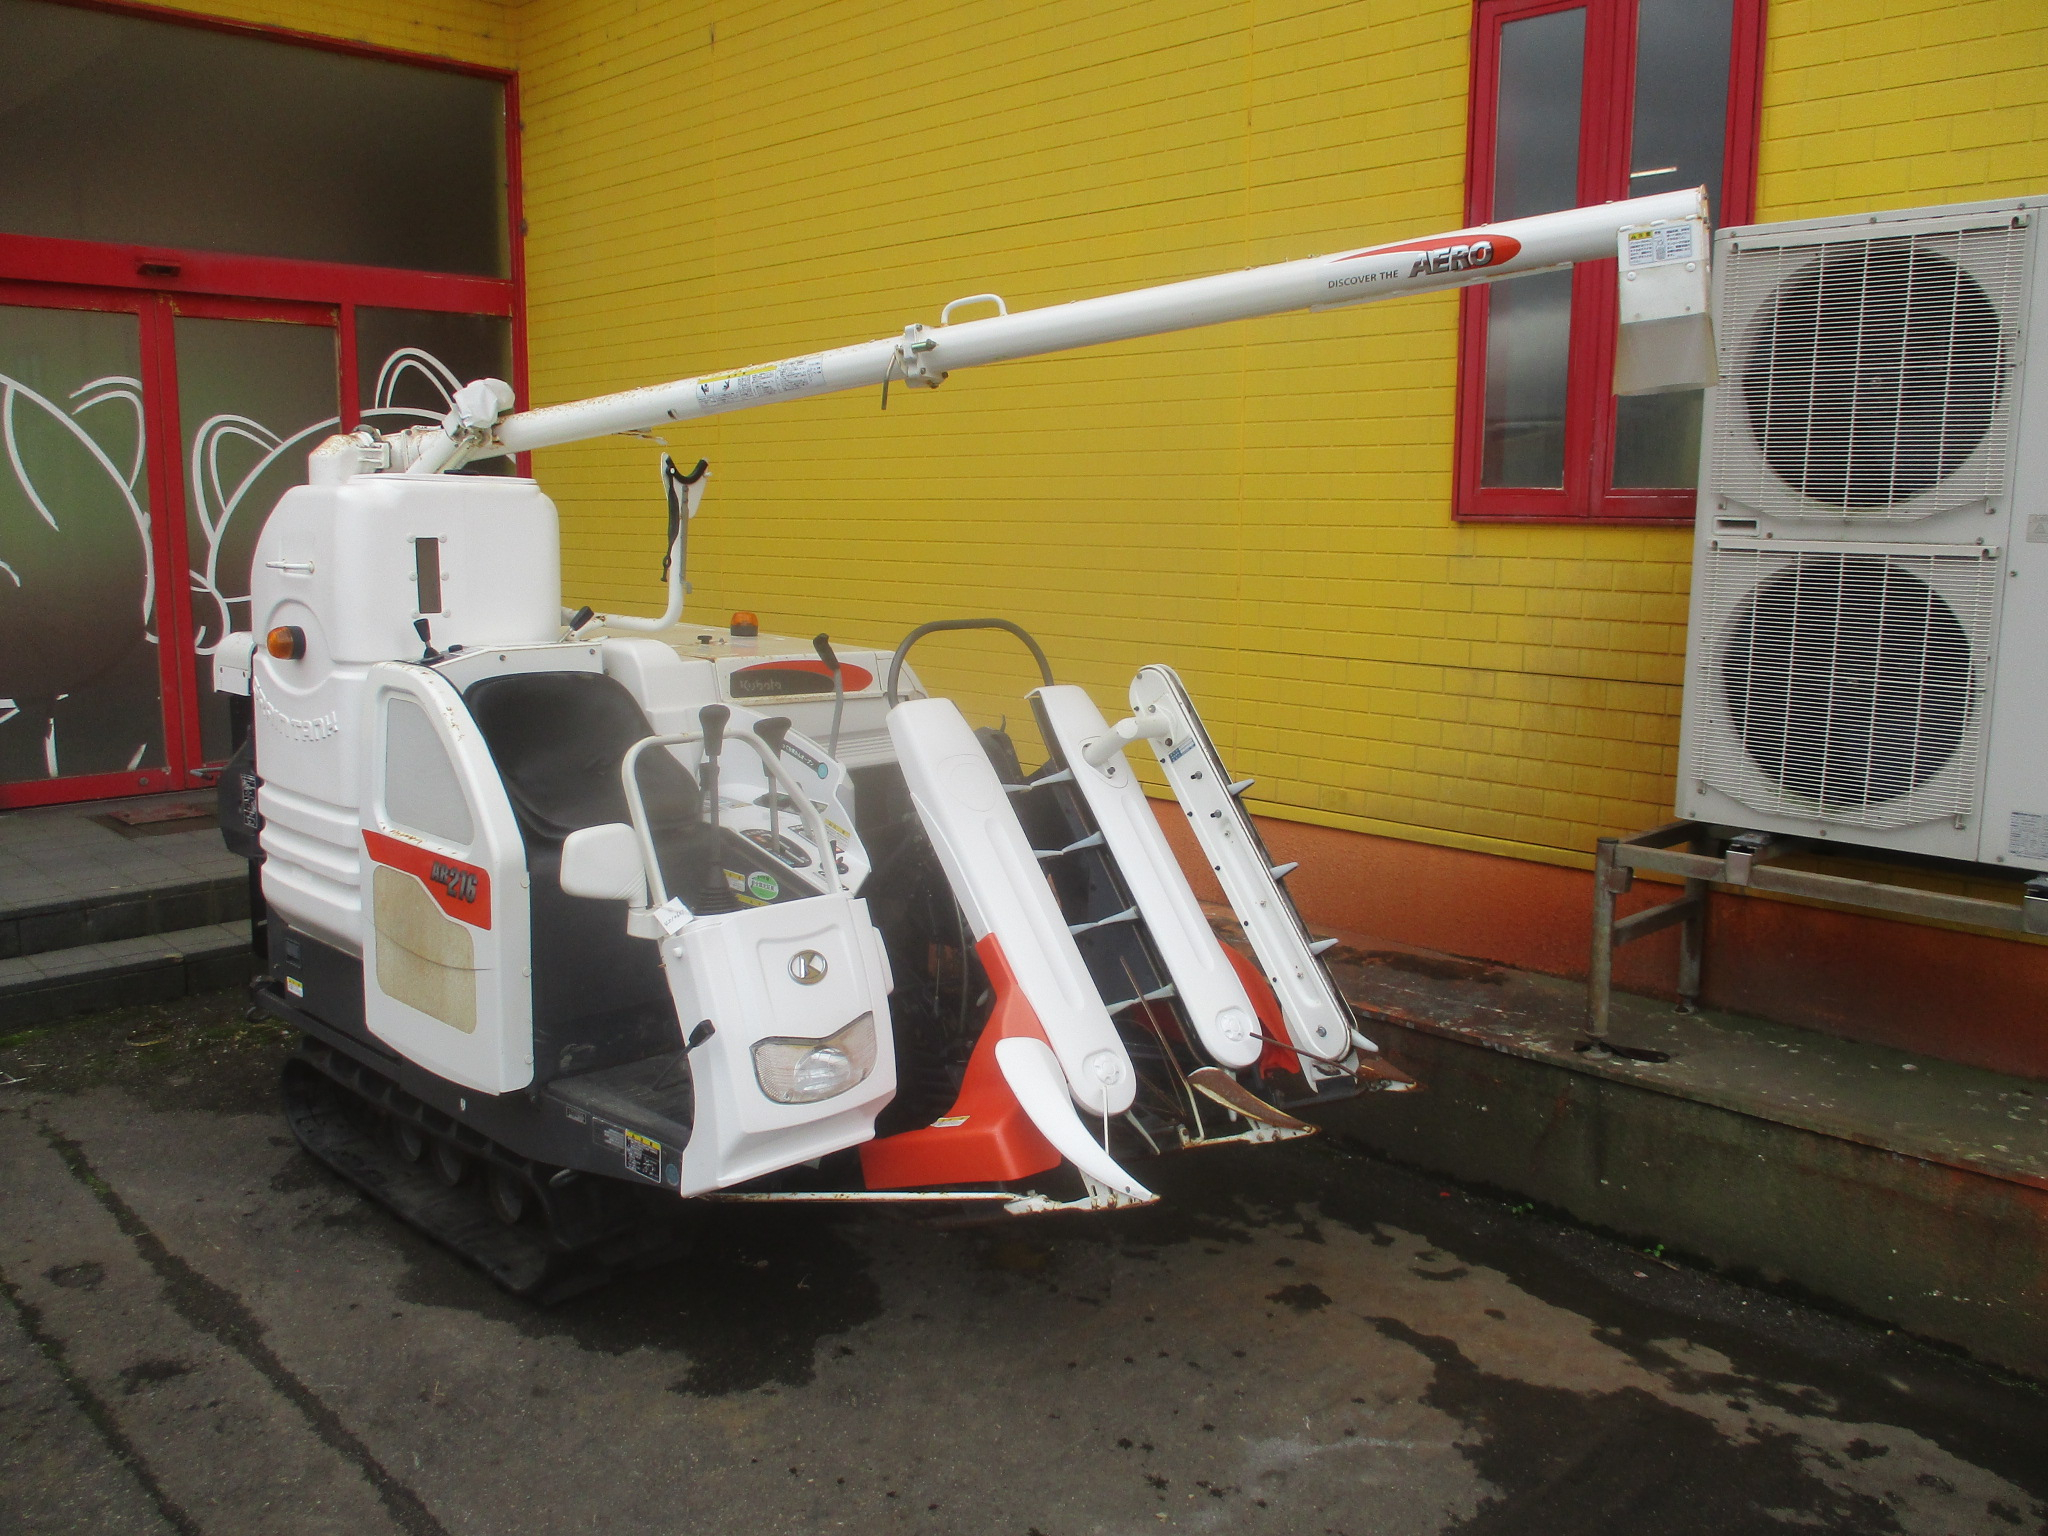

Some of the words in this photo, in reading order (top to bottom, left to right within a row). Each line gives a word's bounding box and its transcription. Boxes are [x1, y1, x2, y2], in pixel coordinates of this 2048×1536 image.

[1328, 271, 1377, 288] DISCOVER
[1380, 269, 1399, 281] THE
[1408, 240, 1494, 278] AERO
[740, 679, 782, 692] Kubota
[430, 860, 478, 904] AR216
